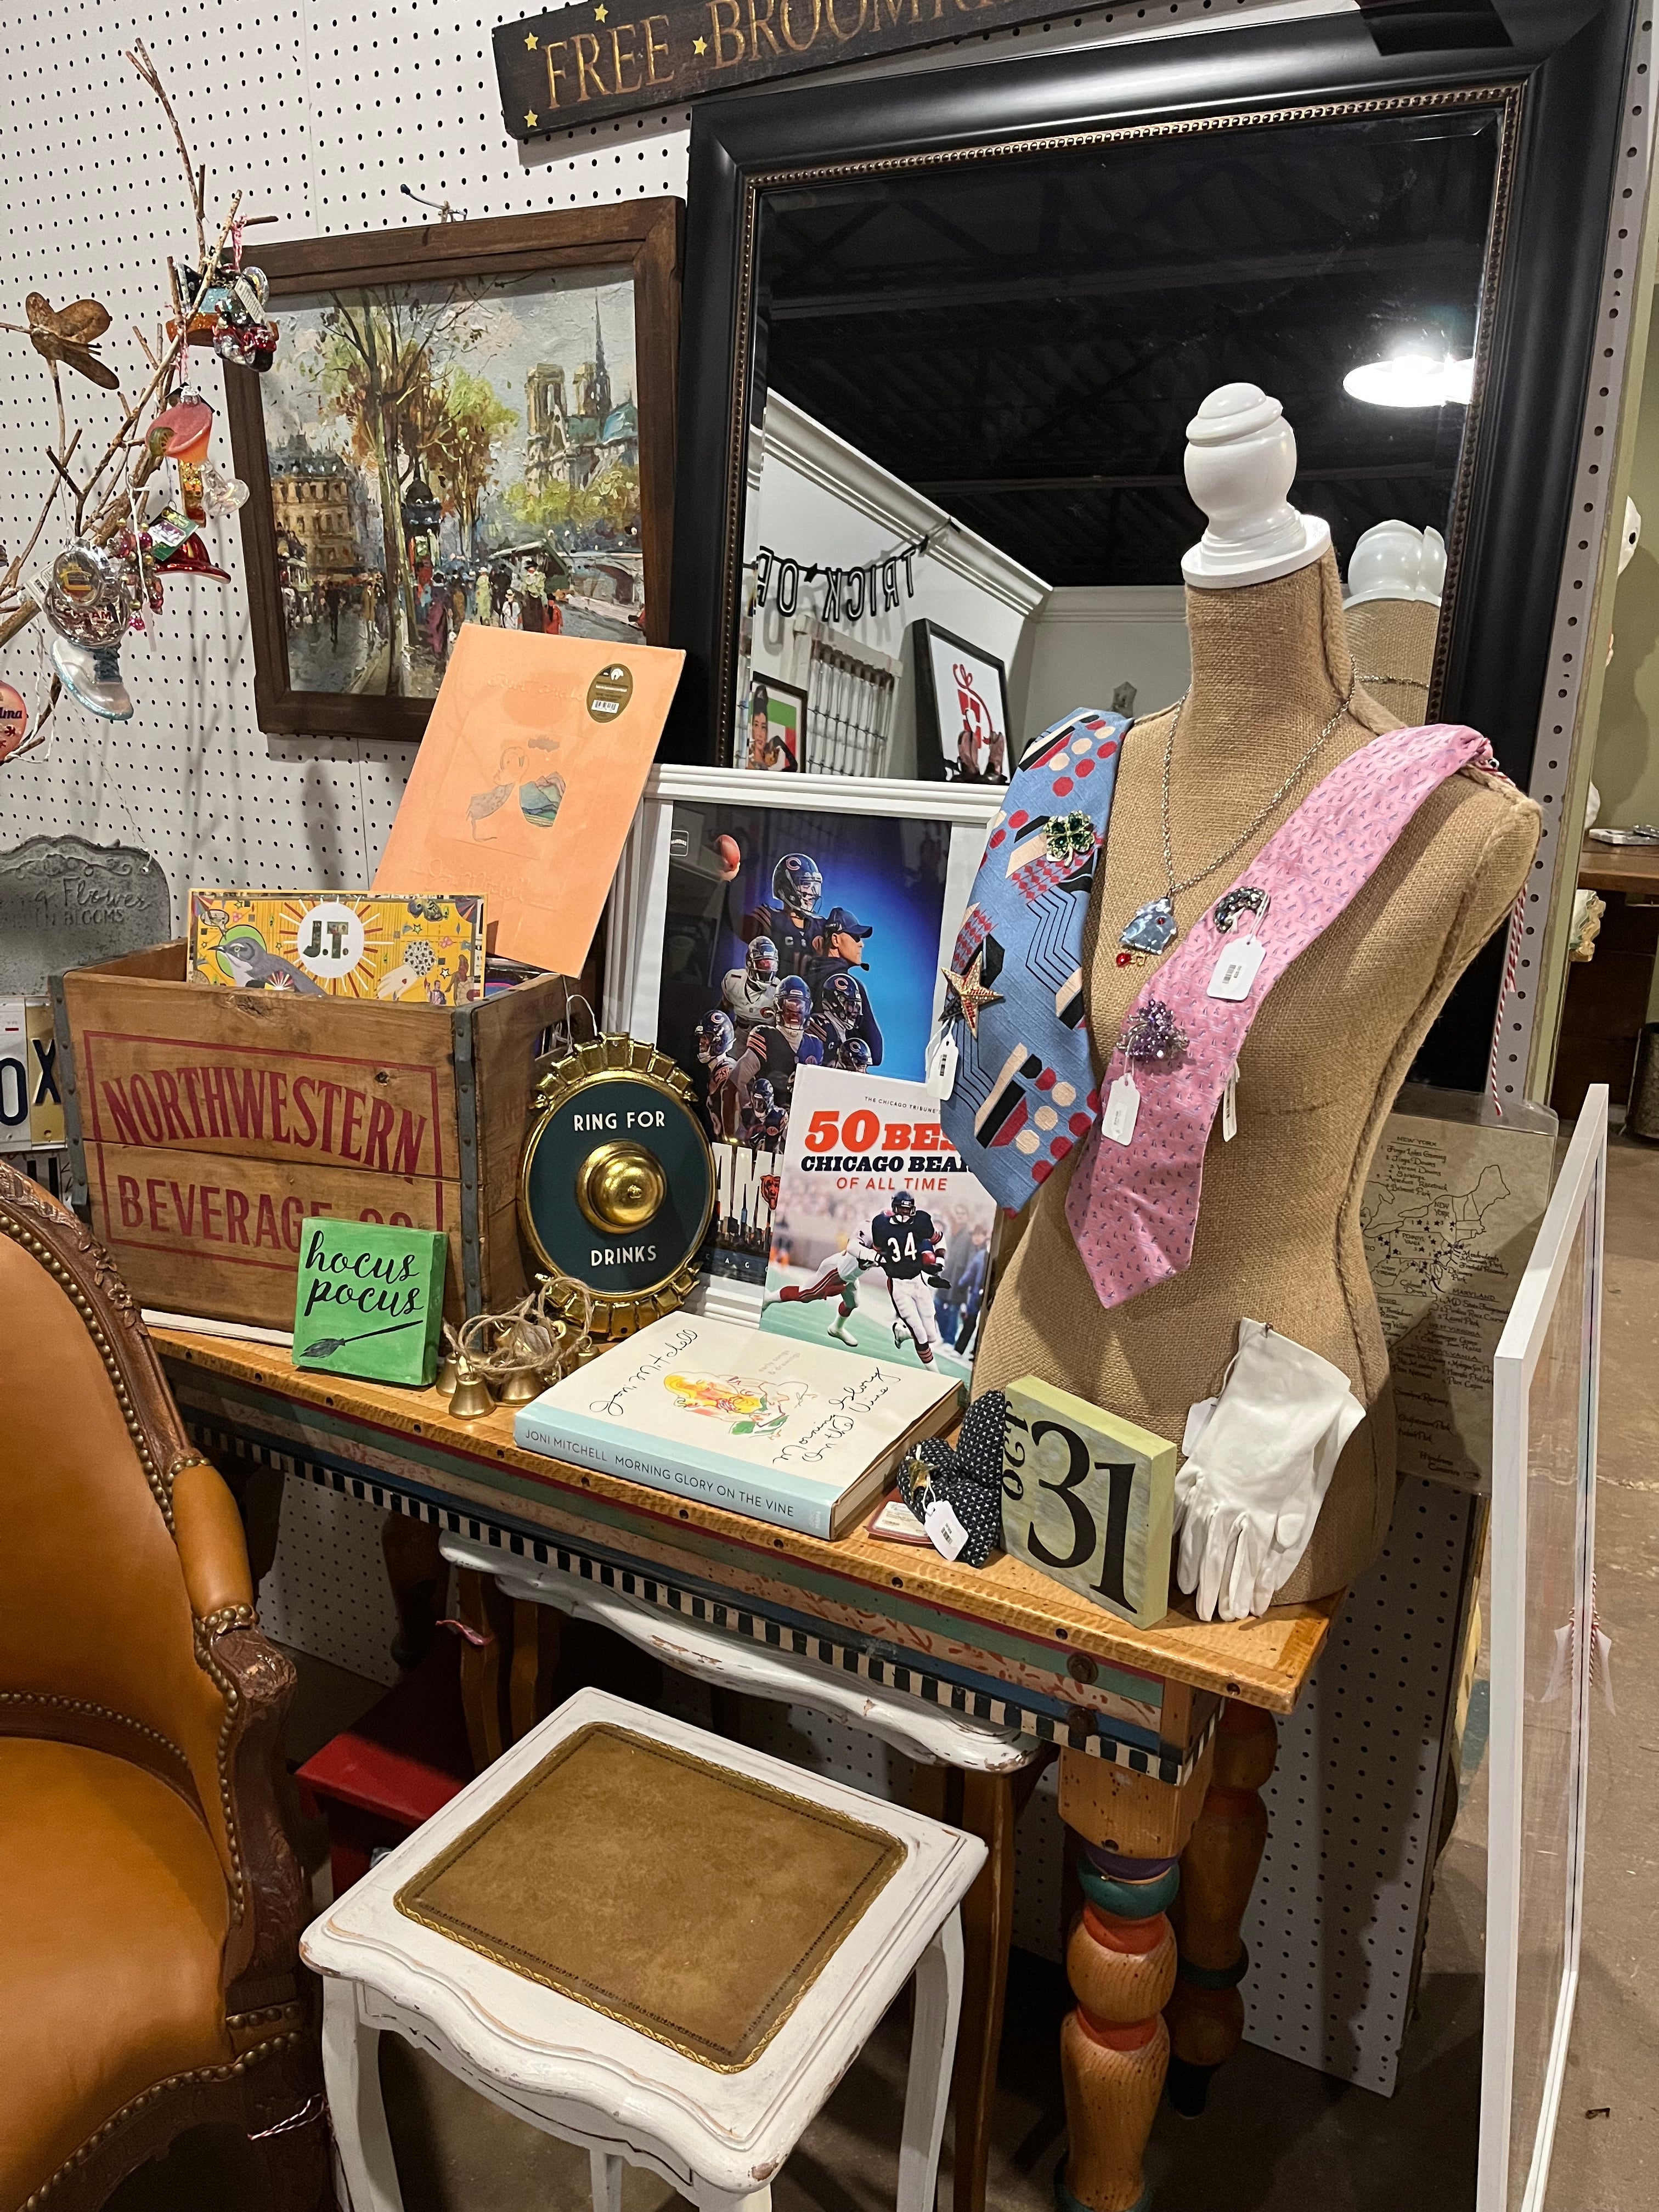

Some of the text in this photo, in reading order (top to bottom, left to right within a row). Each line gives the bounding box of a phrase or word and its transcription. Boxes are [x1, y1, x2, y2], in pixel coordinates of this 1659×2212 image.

[541, 14, 675, 109] FREE
[303, 920, 349, 959] J.T.
[573, 1111, 665, 1132] RING FOR
[878, 1099, 907, 1108] CHICAGO
[100, 1066, 428, 1185] NORTHWESTERN
[804, 1109, 957, 1153] 50 BE
[801, 1155, 973, 1172] CHICAGO BEA
[837, 1177, 948, 1190] OF ALL TIME
[117, 1174, 333, 1254] BEVERAG
[305, 1230, 420, 1284] hocus
[591, 1245, 657, 1267] DRINKS
[888, 1231, 917, 1262] 34
[304, 1278, 425, 1317] pocus
[1452, 1288, 1496, 1301] MARYLAND
[525, 1429, 794, 1517] JONI MITCHELL MORNING GLORY ON THE VINE
[1027, 1420, 1138, 1615] 31
